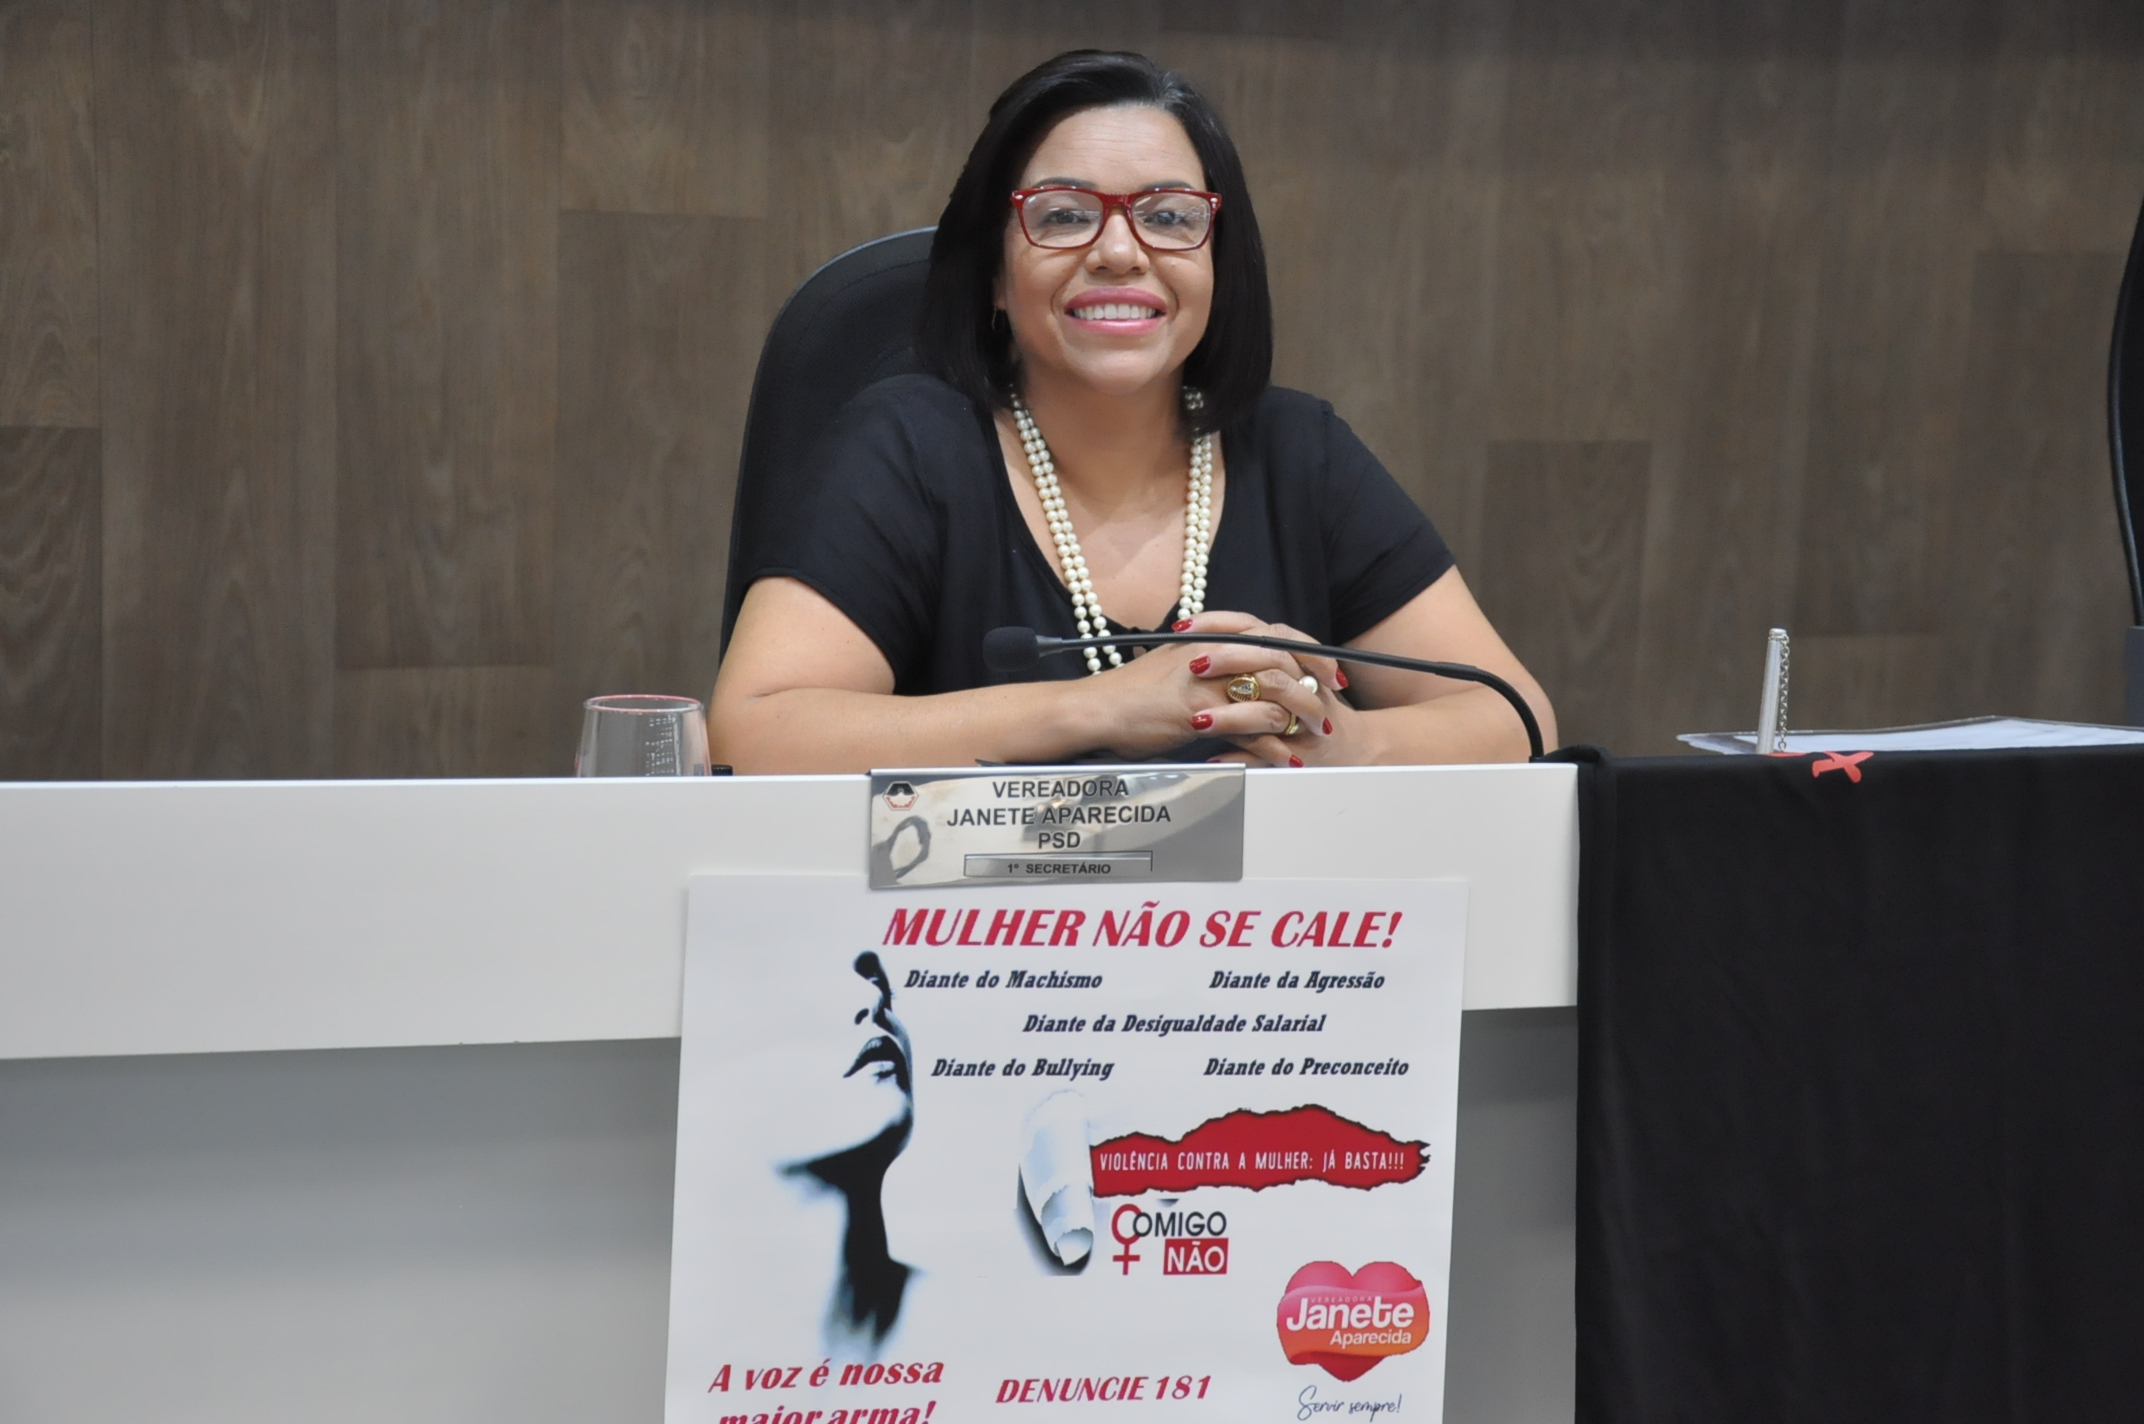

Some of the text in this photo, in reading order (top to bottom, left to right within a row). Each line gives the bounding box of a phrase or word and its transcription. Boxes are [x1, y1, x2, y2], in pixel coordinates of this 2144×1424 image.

[992, 780, 1129, 798] VEREADORA
[946, 805, 1171, 827] JANETE APARECIDA
[1037, 832, 1081, 849] PSD
[1025, 862, 1111, 874] SECRETÁRIO
[882, 900, 1403, 948] MULHER NÃO SE CALE!
[904, 970, 1103, 988] Diante do Machismo
[1208, 970, 1385, 993] Diante da Agressão
[1022, 1014, 1327, 1037] Diante da Desigualdade Salarial
[931, 1058, 1115, 1081] Diante do Bullying
[1203, 1057, 1409, 1076] Diante do Preconceito
[1100, 1149, 1404, 1173] VIOLÊNCIA CONTRA A MULHER: JÁ BASTA!!!
[1167, 1240, 1225, 1273] NÃO
[1286, 1296, 1415, 1331] Janete
[1329, 1329, 1412, 1350] Aparecida
[707, 1358, 945, 1393] A voz é nossa
[996, 1374, 1212, 1404] DENUNCIE 181
[1297, 1385, 1403, 1423] Servir sempre!
